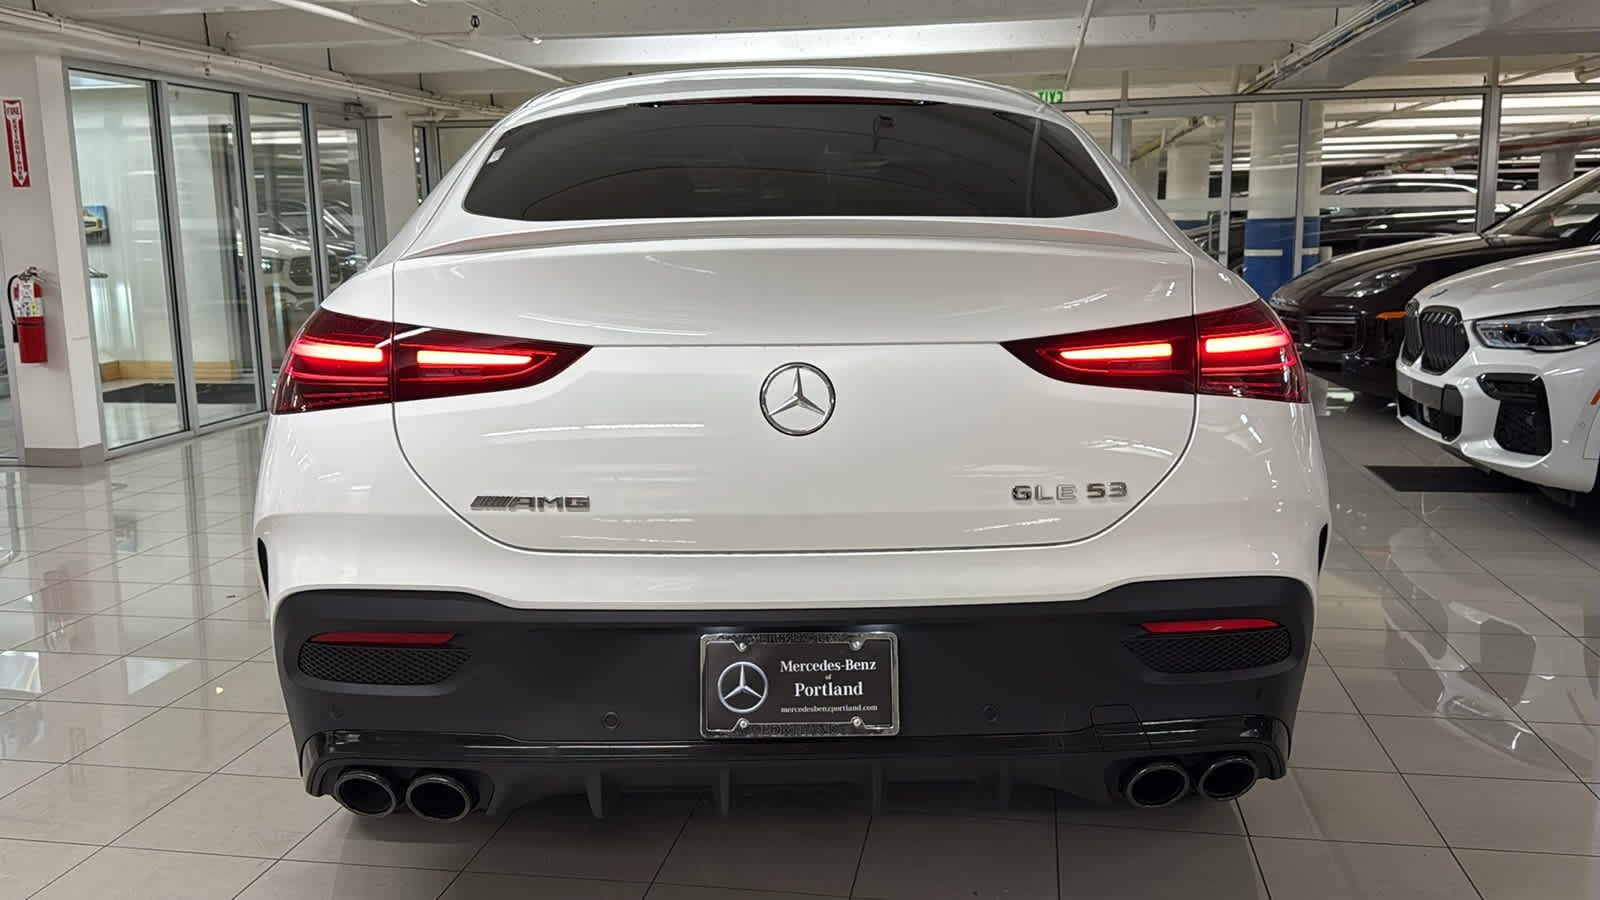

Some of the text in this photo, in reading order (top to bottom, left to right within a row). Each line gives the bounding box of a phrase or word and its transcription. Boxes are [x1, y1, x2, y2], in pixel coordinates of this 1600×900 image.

[6, 106, 20, 115] FIRE
[1011, 482, 1128, 502] GLE 53
[507, 495, 590, 512] AMG
[780, 659, 877, 673] Mercedes-Benz
[794, 681, 864, 697] Portland
[780, 704, 878, 714] mercedesbenzportland.com
